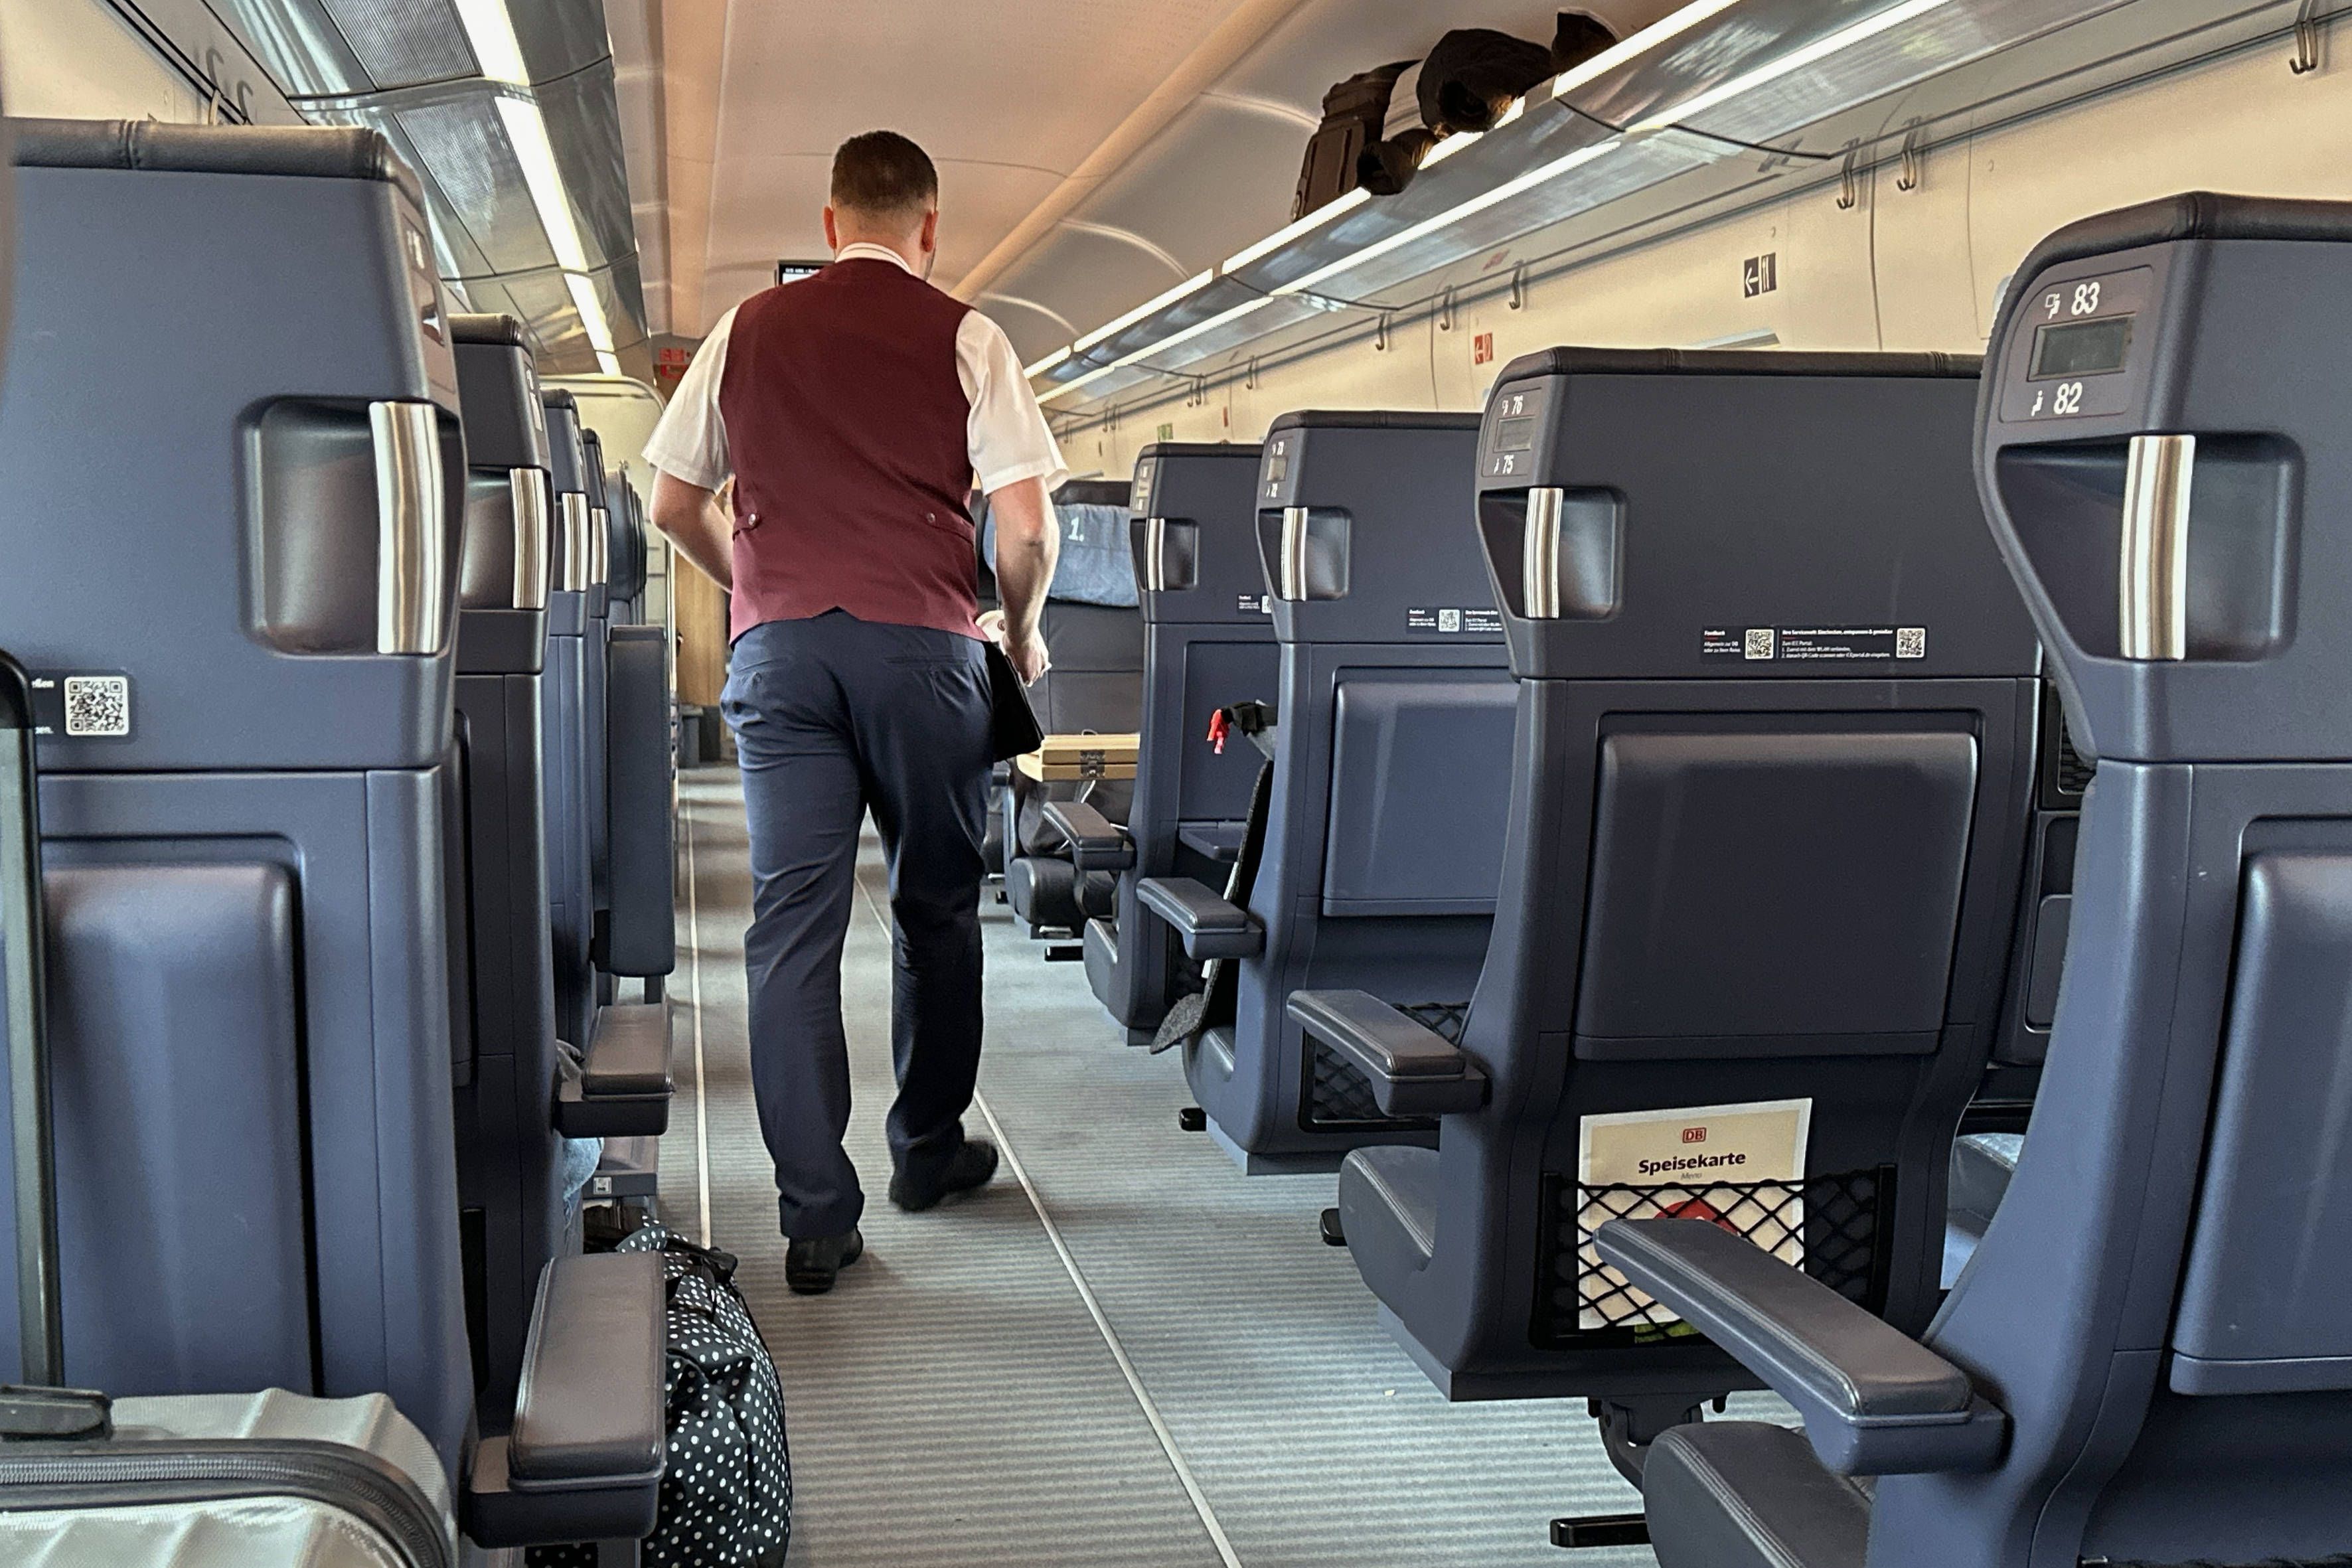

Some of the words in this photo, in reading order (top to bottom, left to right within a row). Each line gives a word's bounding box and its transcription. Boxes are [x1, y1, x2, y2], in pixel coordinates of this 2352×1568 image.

[2071, 282, 2100, 315] 83
[1512, 395, 1524, 414] 76
[2053, 382, 2082, 414] 82
[1502, 455, 1514, 474] 75
[1685, 1129, 1704, 1141] DB
[1639, 1152, 1746, 1176] Speisekarte
